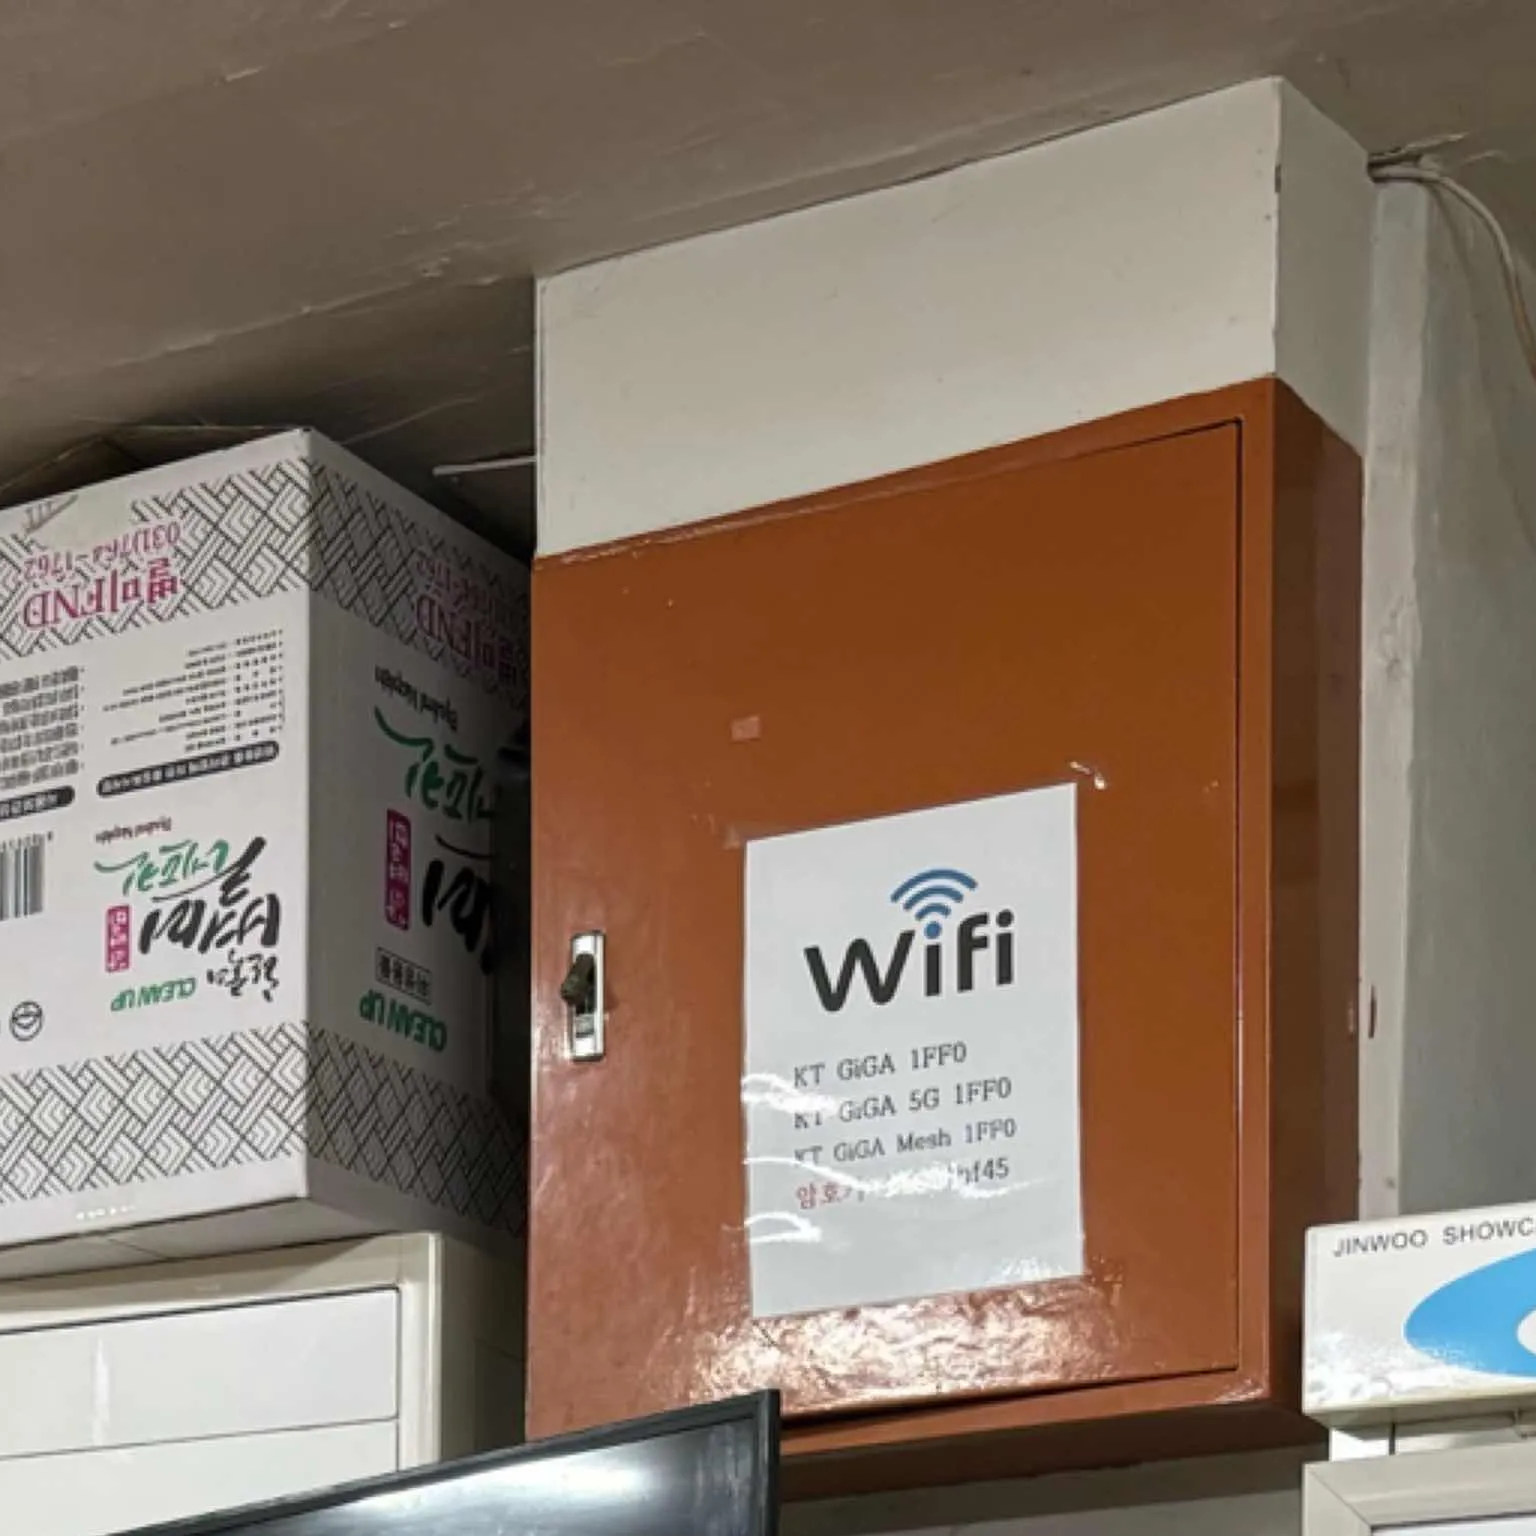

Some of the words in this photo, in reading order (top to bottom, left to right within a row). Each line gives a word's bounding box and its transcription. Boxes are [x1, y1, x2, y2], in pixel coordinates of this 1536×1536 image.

[804, 907, 1014, 1012] Wifi
[110, 988, 136, 1012] UP
[137, 976, 197, 1008] CLEAN
[358, 988, 385, 1024] UP
[387, 997, 448, 1053] CLEAN
[794, 1063, 826, 1088] KT
[908, 1088, 940, 1112] 5G
[896, 1127, 952, 1153] Mesh
[1332, 1227, 1430, 1260] JINWOO
